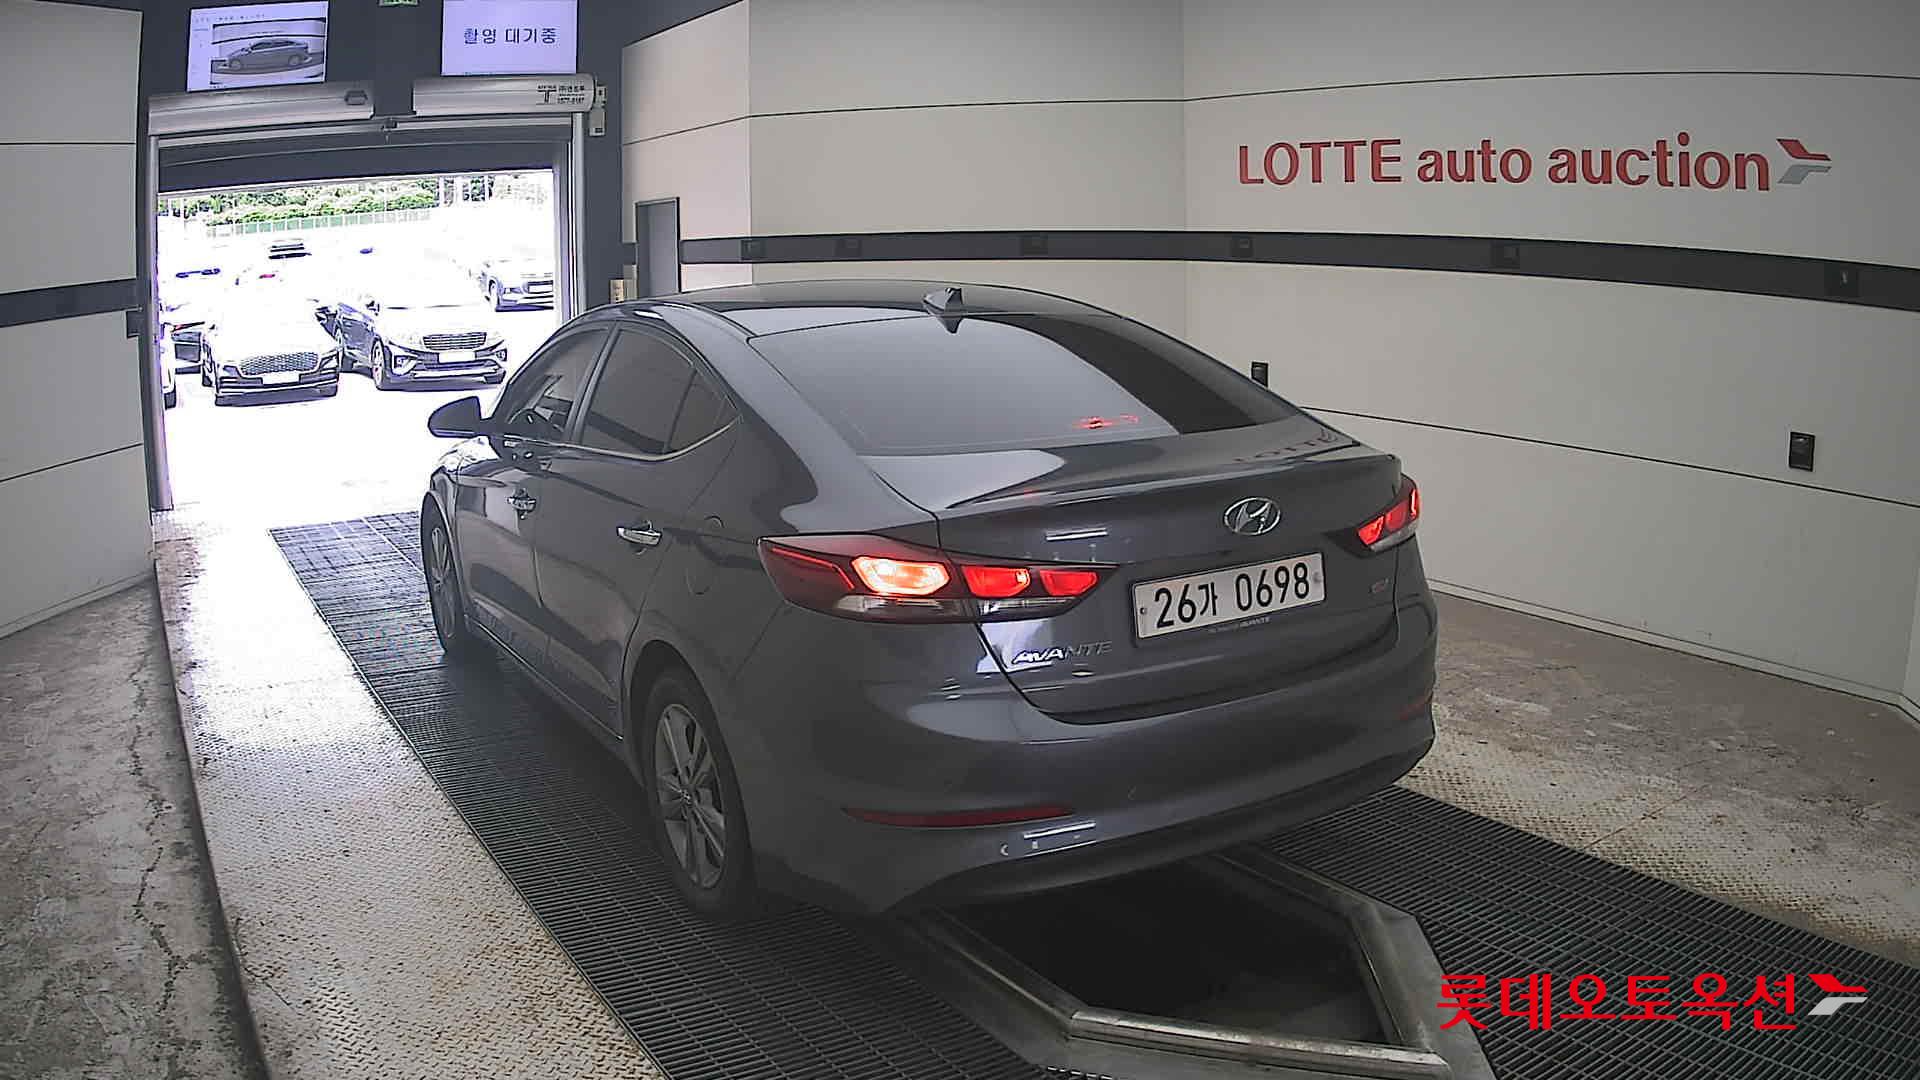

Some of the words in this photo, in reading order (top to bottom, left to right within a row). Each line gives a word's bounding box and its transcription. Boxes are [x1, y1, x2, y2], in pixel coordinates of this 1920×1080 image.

[504, 27, 557, 45] 대기중
[1239, 138, 1402, 185] LOTTE
[1416, 138, 1532, 185] auto
[1547, 132, 1769, 191] auction
[1154, 581, 1218, 629] 26가
[1234, 562, 1310, 611] 0698
[1012, 641, 1112, 664] AVANTE
